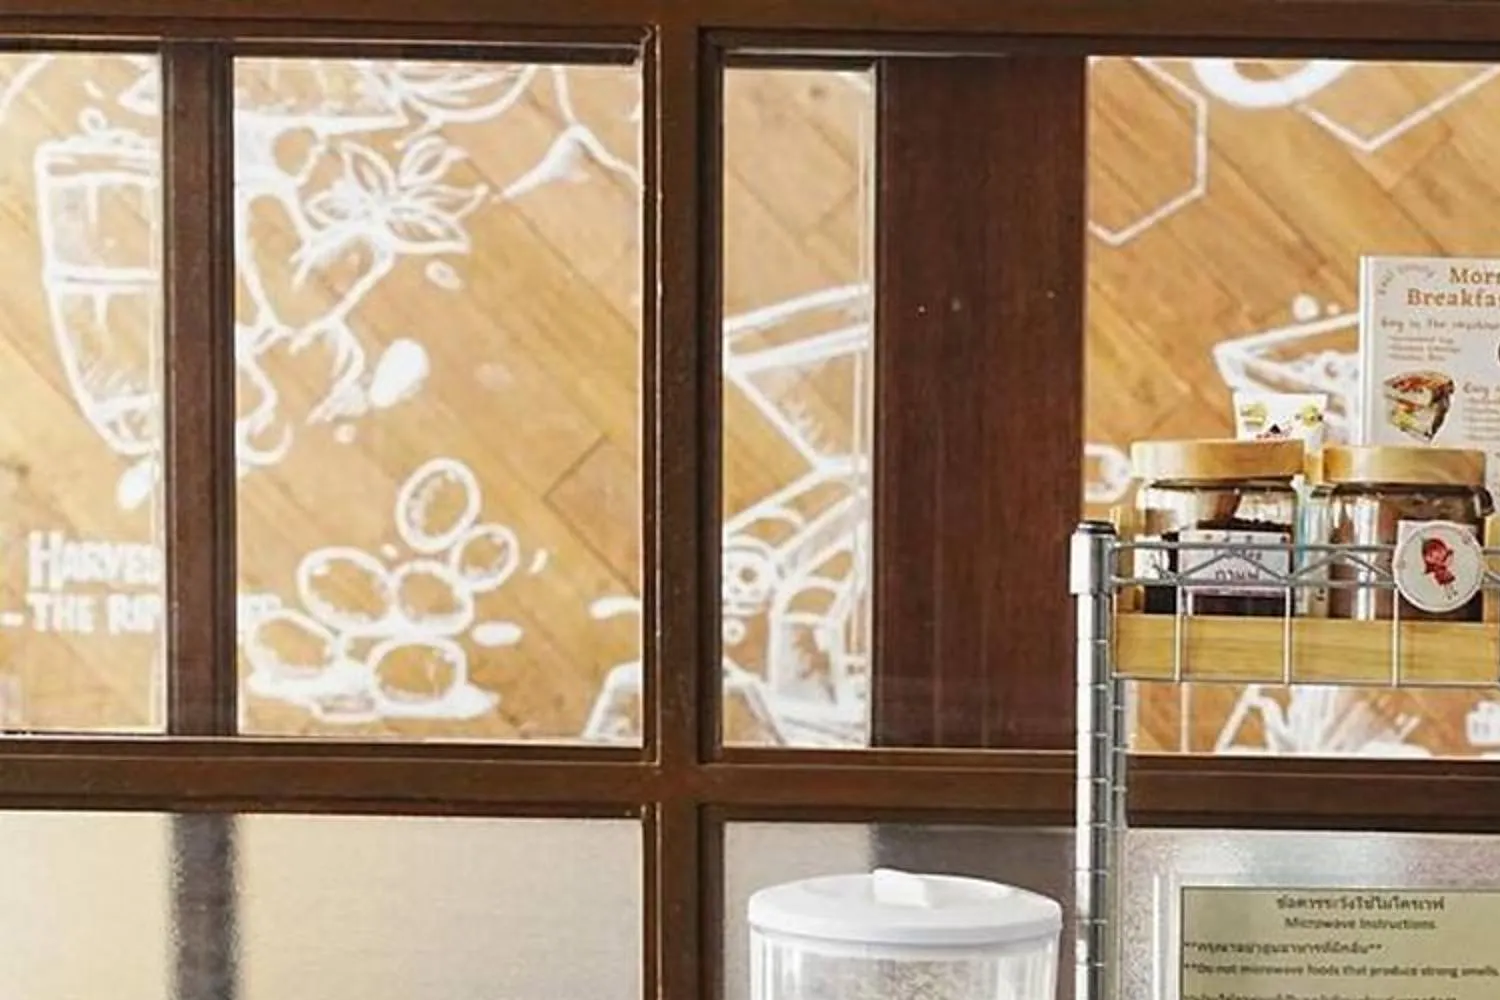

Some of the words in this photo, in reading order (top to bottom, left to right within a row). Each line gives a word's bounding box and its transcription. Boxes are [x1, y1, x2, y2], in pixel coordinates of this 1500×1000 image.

[1285, 917, 1355, 930] Microwave
[1359, 918, 1436, 930] Instructions
[1343, 965, 1367, 977] that
